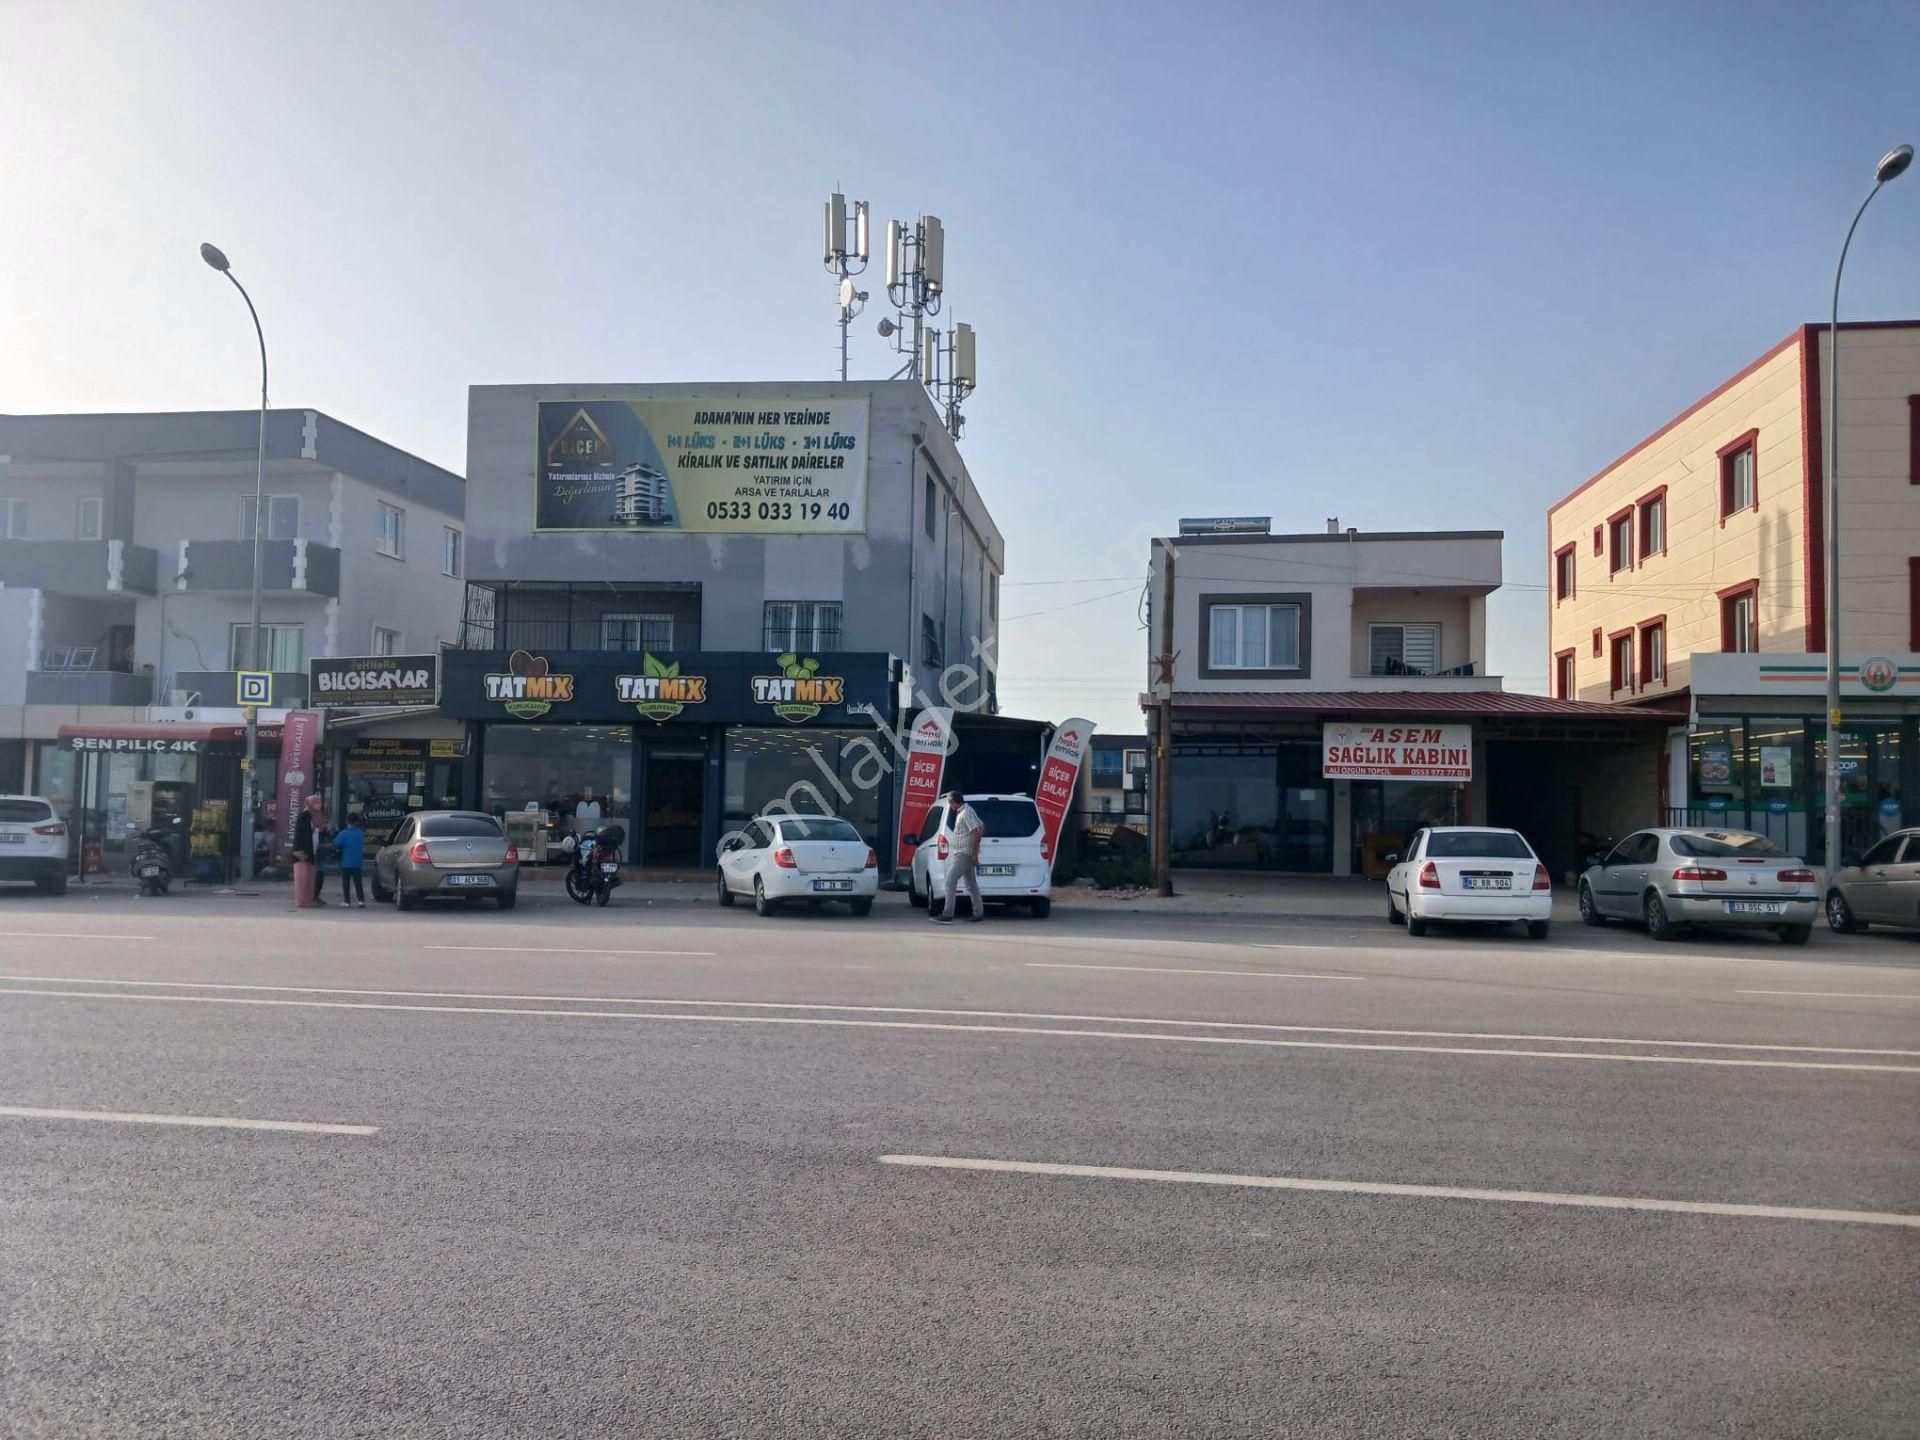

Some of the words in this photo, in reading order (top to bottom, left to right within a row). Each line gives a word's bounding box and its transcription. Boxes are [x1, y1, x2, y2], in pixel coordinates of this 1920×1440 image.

[693, 411, 756, 425] ADANA'NIN
[758, 411, 780, 425] HER
[783, 408, 831, 425] YERİNDE
[684, 431, 715, 449] LÜKS
[754, 432, 786, 450] LÜKS
[824, 431, 856, 450] LÜKS
[677, 451, 724, 468] KİRALIK
[725, 455, 741, 468] VE
[743, 455, 789, 469] SATILIK
[791, 452, 844, 470] DAİRELER
[753, 475, 791, 485] YATIRIM
[793, 474, 812, 486] İÇİN
[734, 487, 761, 497] ARSA
[764, 488, 776, 497] VE
[779, 488, 830, 498] TARLALAR
[707, 501, 751, 519] 0533
[758, 502, 792, 520] 033
[800, 502, 821, 520] 19
[827, 502, 850, 520] 40
[248, 681, 261, 696] D
[1370, 727, 1443, 744] ASEM
[72, 737, 112, 751] ŞEN
[170, 740, 197, 752] 4K
[1328, 742, 1396, 764] SAĞLIK
[1402, 744, 1468, 766] KABİNİ
[909, 776, 935, 789] EMLAK
[1042, 781, 1069, 798] EMLAK
[1495, 879, 1510, 887] 904
